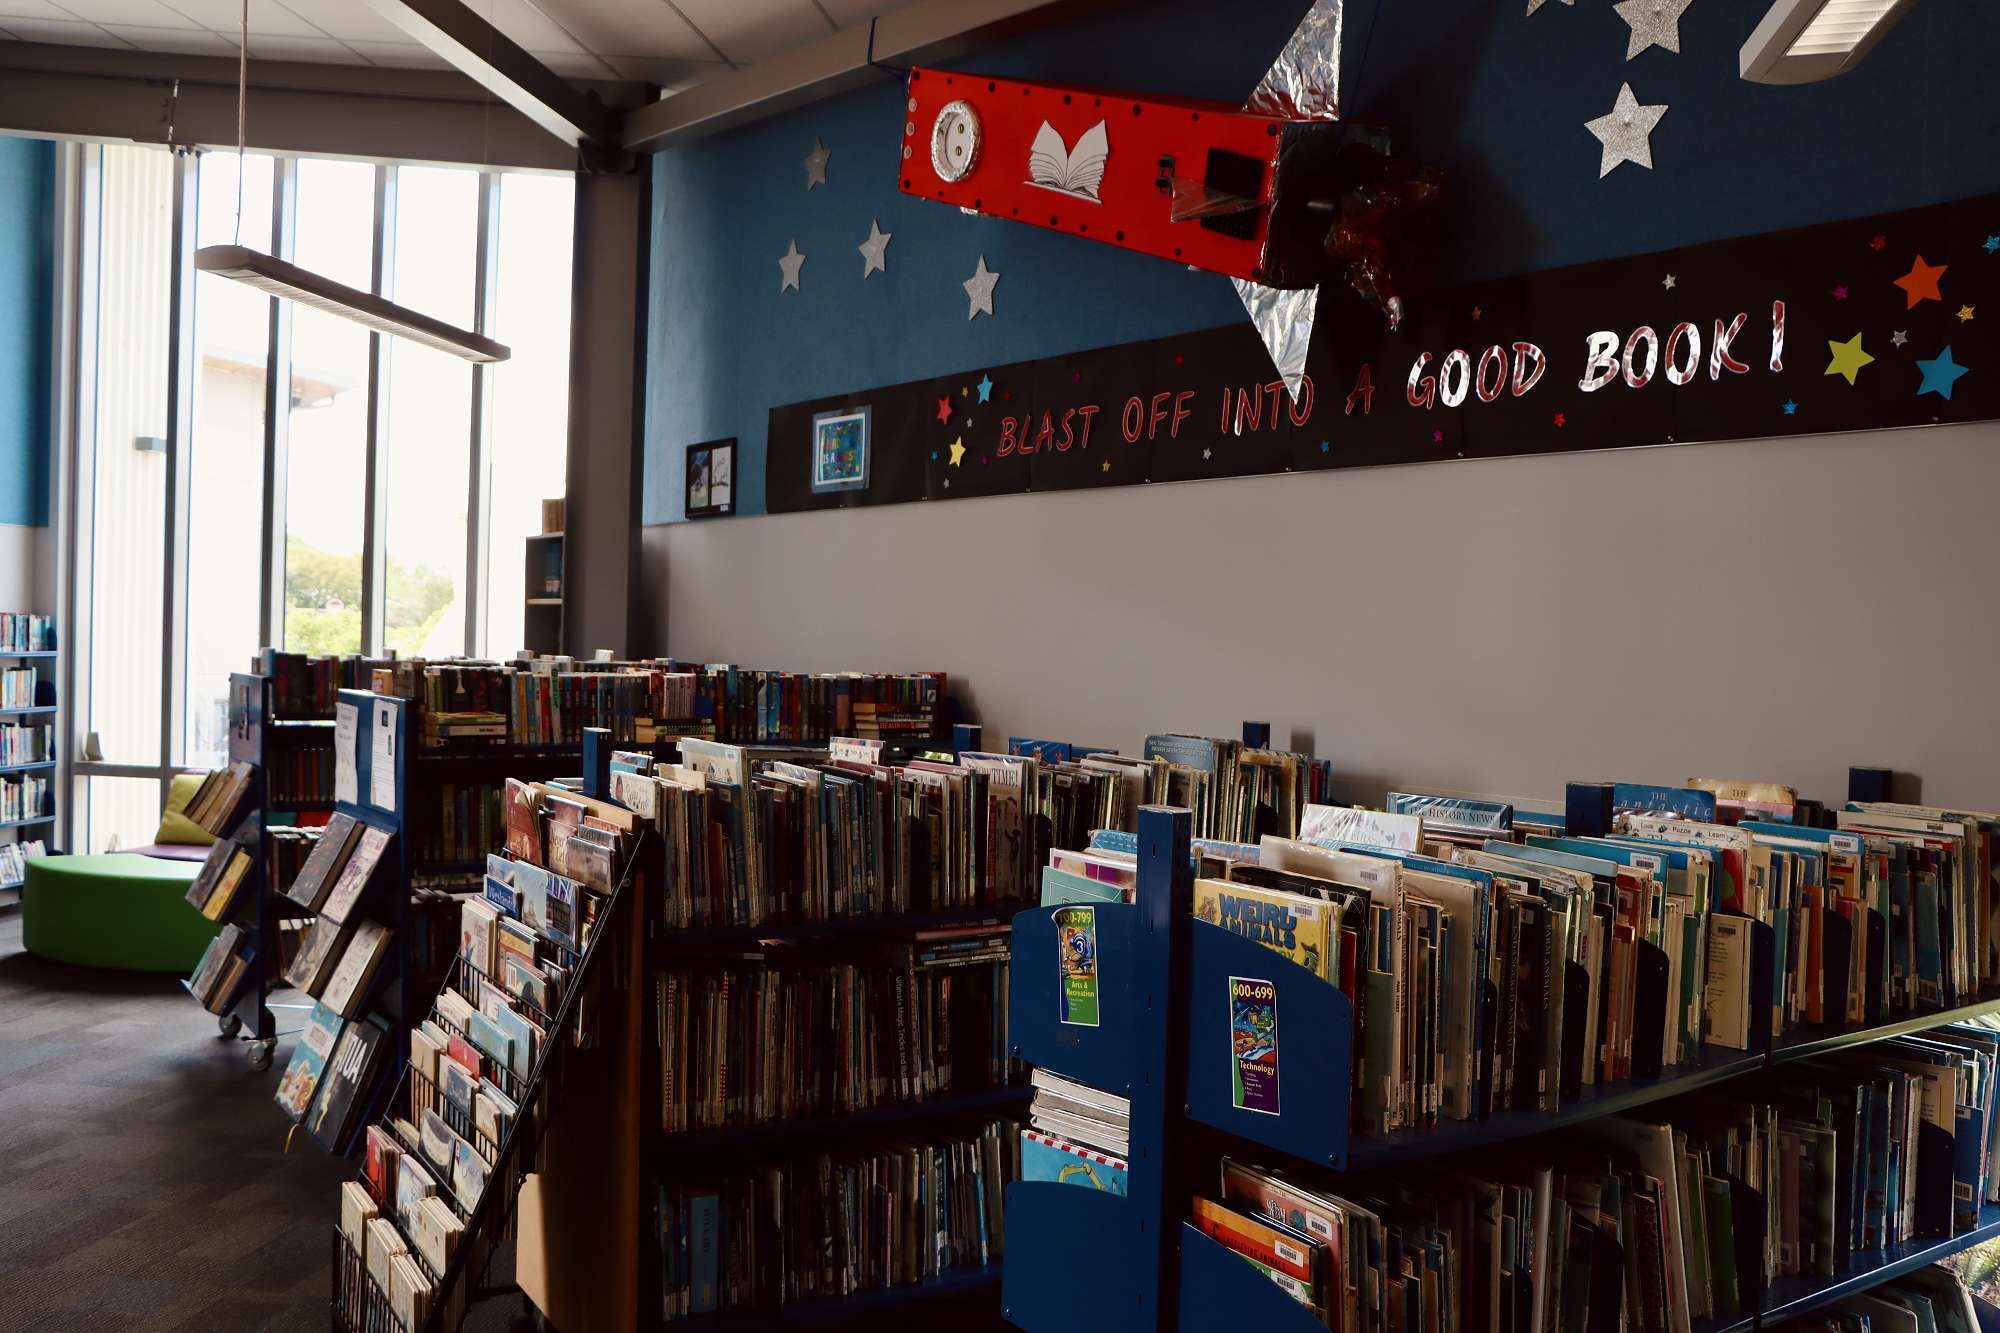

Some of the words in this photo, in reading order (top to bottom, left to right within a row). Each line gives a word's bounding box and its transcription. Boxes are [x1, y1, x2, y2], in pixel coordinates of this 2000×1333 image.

[997, 404, 1101, 457] BLAST
[1121, 390, 1195, 443] OFF
[1221, 375, 1314, 437] INTO
[1345, 363, 1375, 415] A
[1407, 342, 1545, 409] GOOD
[1651, 791, 1667, 801] THE
[1620, 798, 1712, 817] antastic
[1429, 808, 1467, 821] HISTORY
[1469, 812, 1495, 825] NEWS
[1058, 911, 1092, 924] 700-799
[1395, 901, 1403, 941] ANIMALS
[1232, 983, 1273, 999] 600-699
[1543, 957, 1552, 1010] ANIMALS
[1067, 988, 1095, 997] Recreation
[1239, 1059, 1275, 1076] Technology
